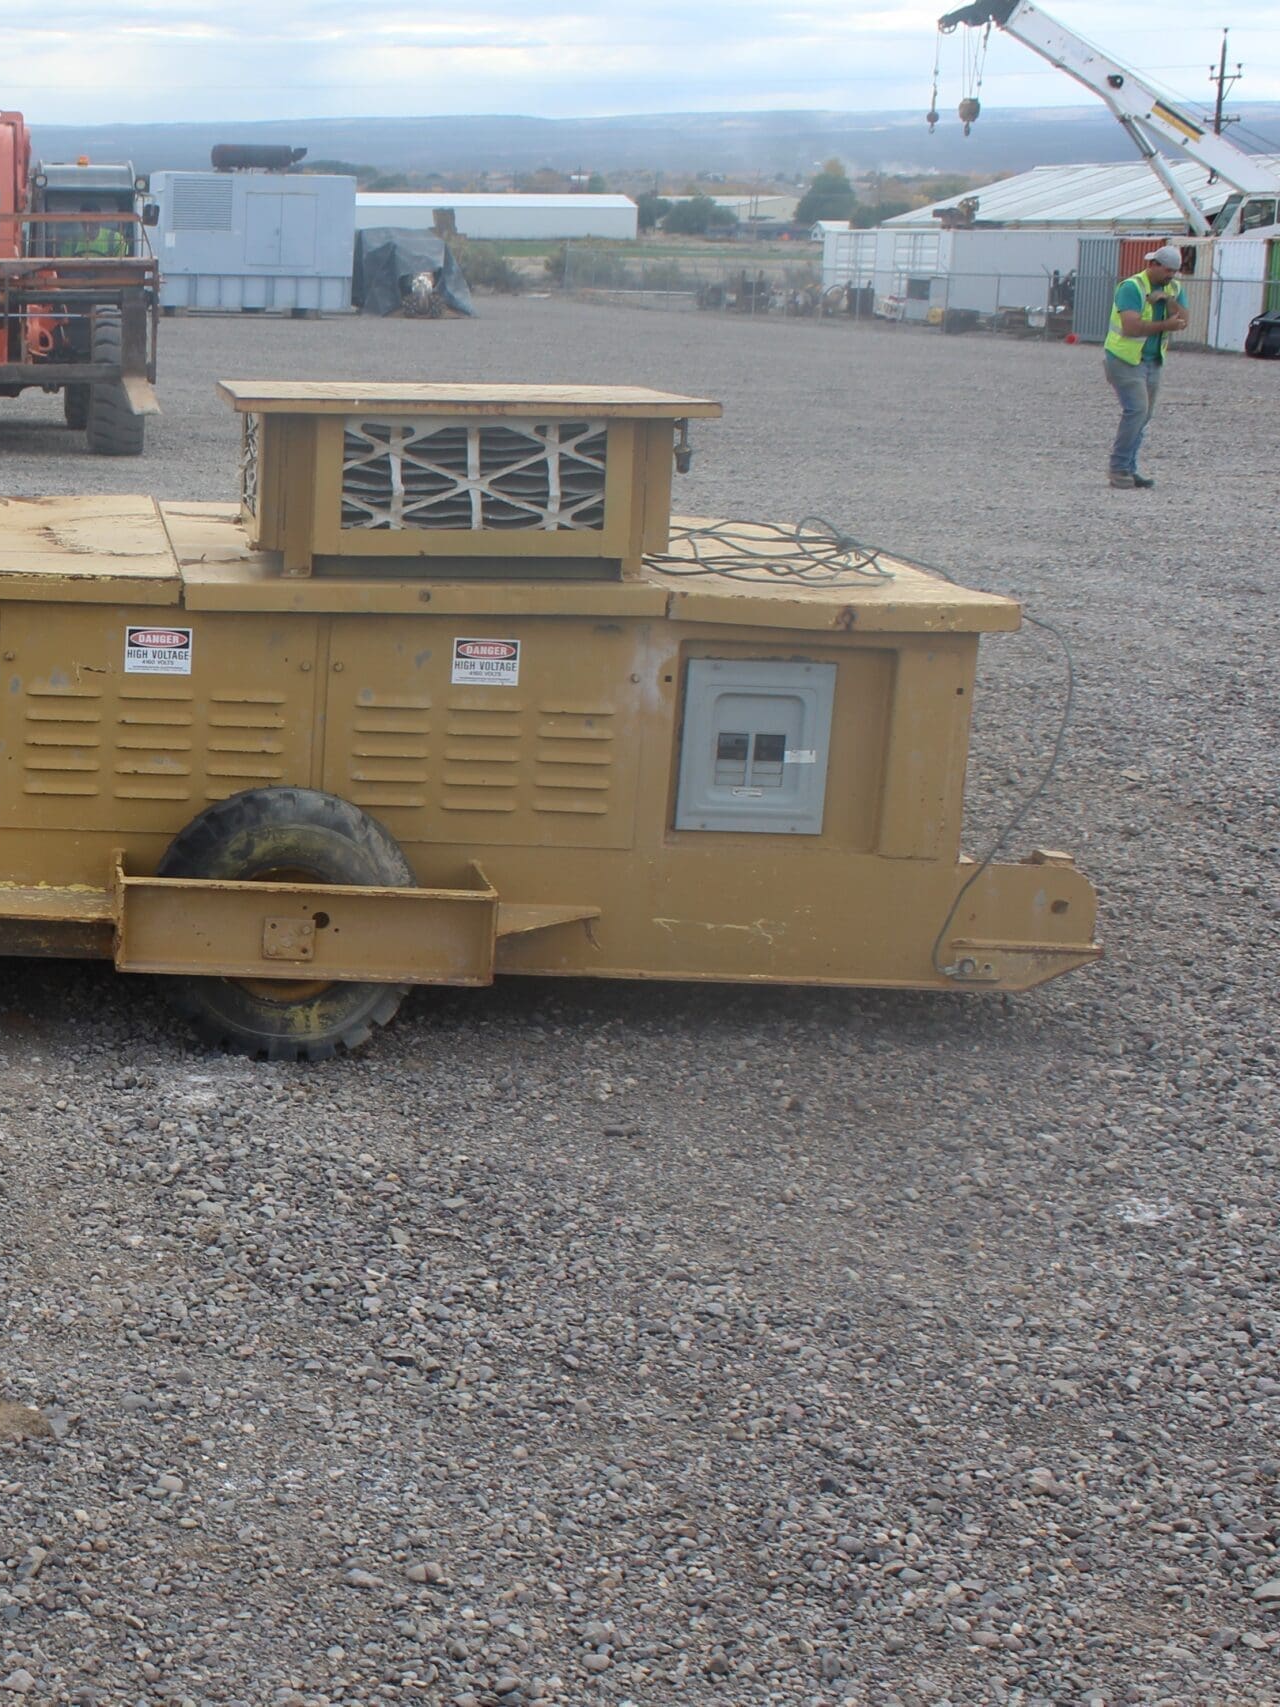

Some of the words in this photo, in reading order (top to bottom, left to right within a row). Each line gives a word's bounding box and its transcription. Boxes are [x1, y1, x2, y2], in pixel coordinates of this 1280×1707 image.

[138, 634, 180, 644] DANGER
[128, 649, 148, 658] HIGH
[152, 650, 190, 660] VOLTAGE
[466, 646, 507, 656] DANGER
[455, 660, 476, 670] HIGH
[479, 661, 518, 672] VOLTAGE
